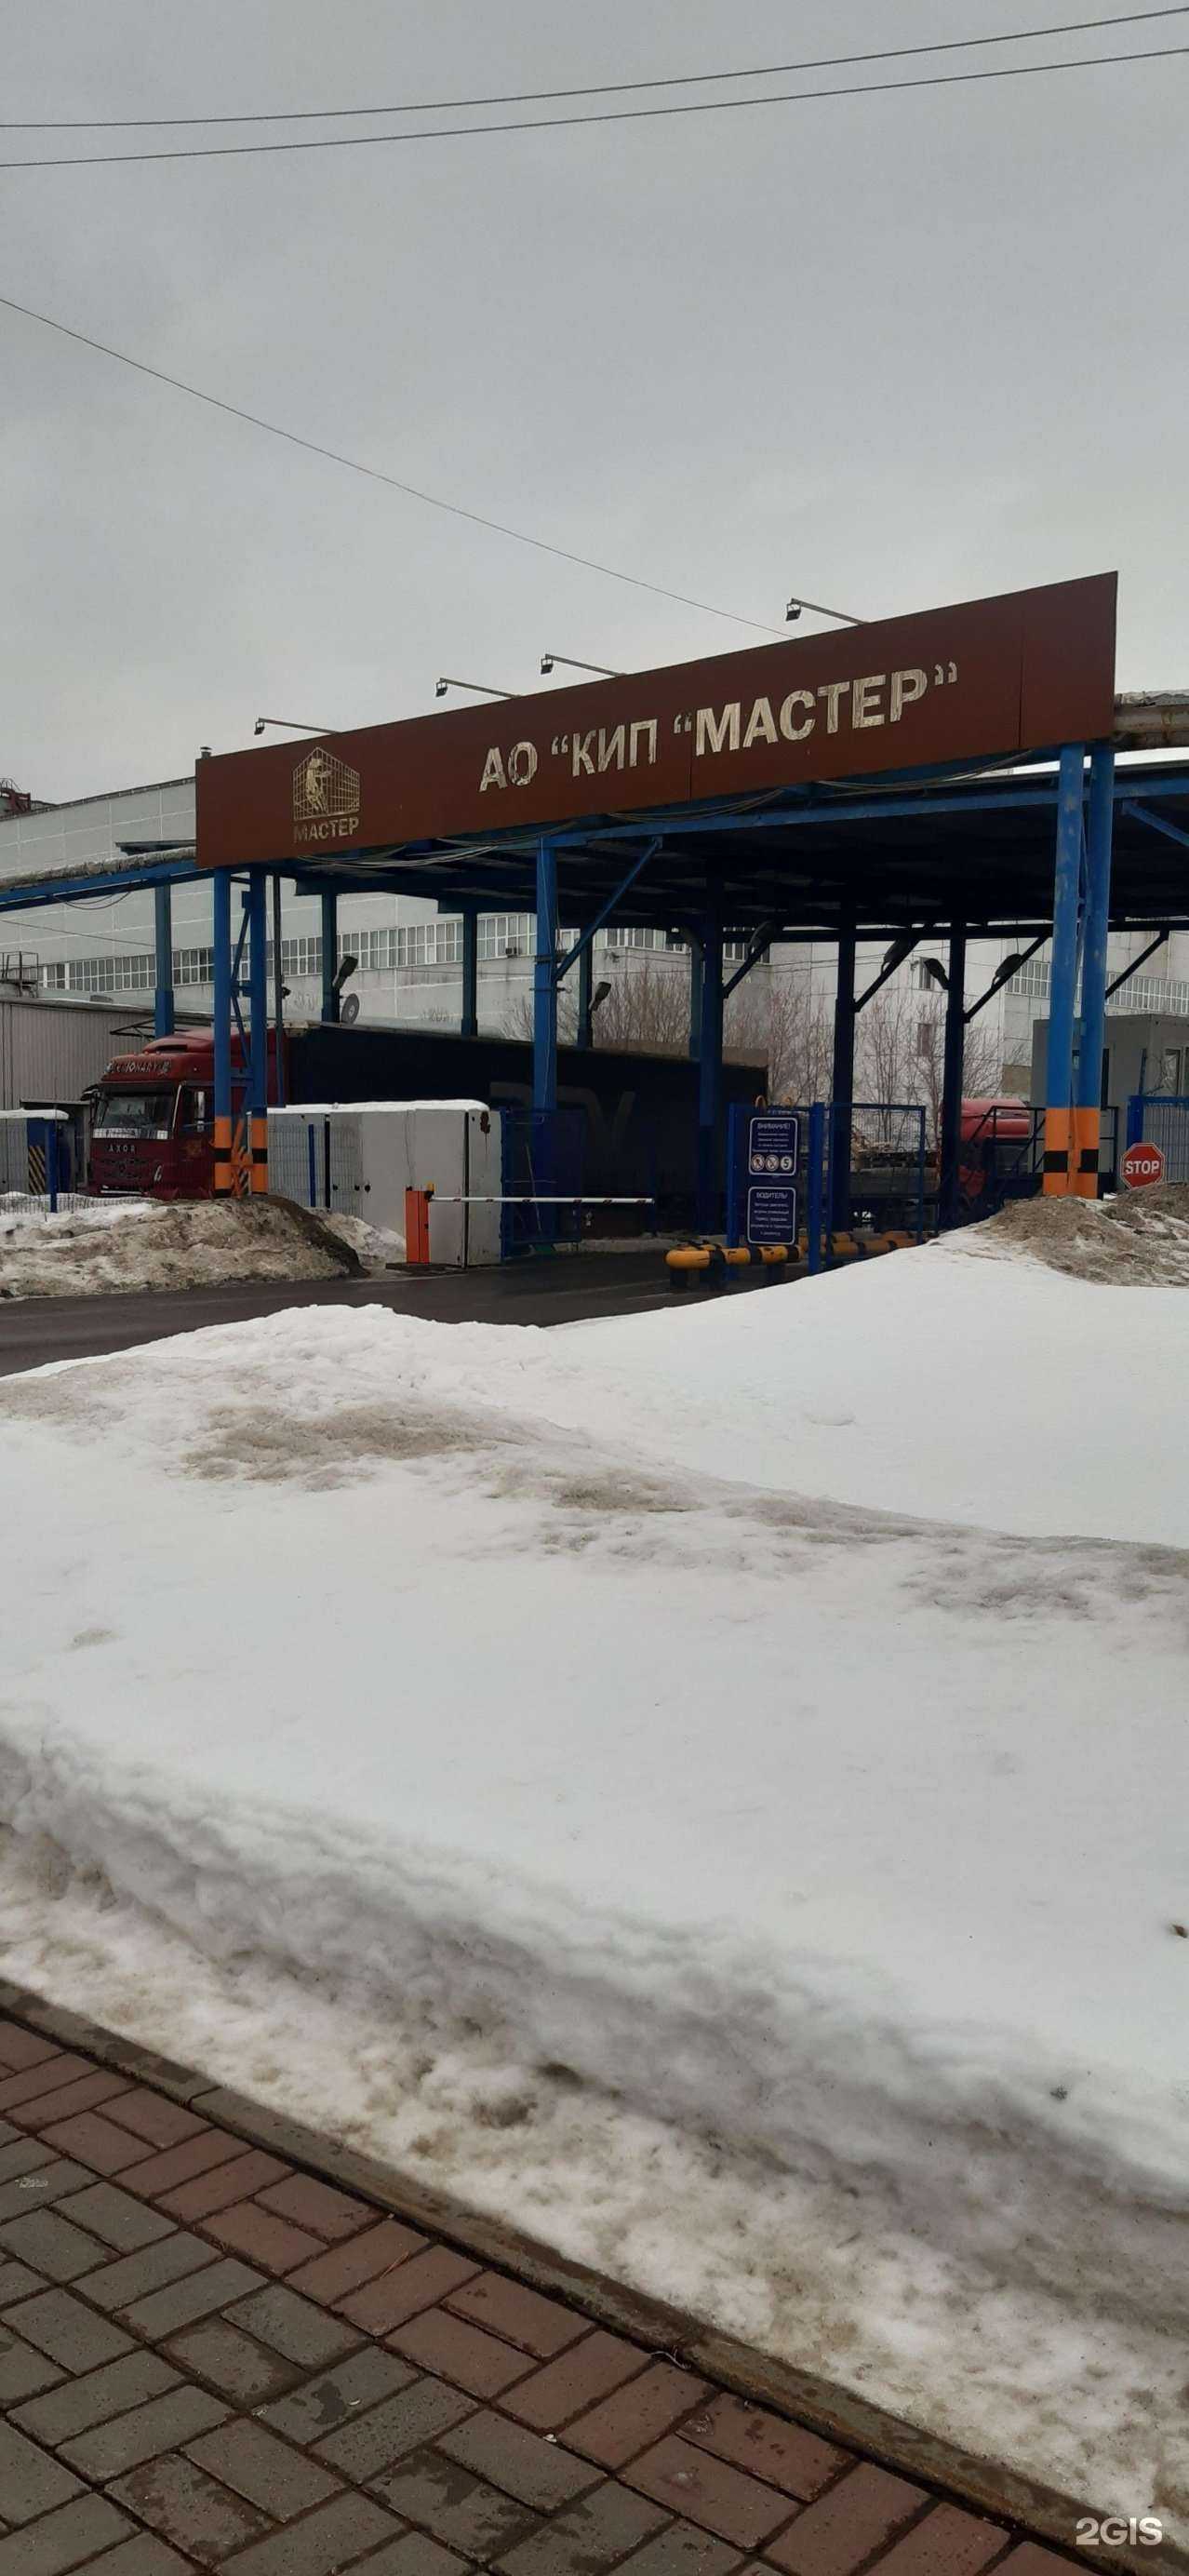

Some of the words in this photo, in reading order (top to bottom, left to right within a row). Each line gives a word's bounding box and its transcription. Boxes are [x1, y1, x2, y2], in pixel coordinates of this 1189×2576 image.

[478, 741, 538, 792] АО
[551, 718, 658, 777] “КИП
[674, 662, 957, 757] “МАСТЕР”
[294, 817, 359, 843] МАСТЕР
[109, 1145, 135, 1153] AXOR
[1125, 1161, 1160, 1174] STOP
